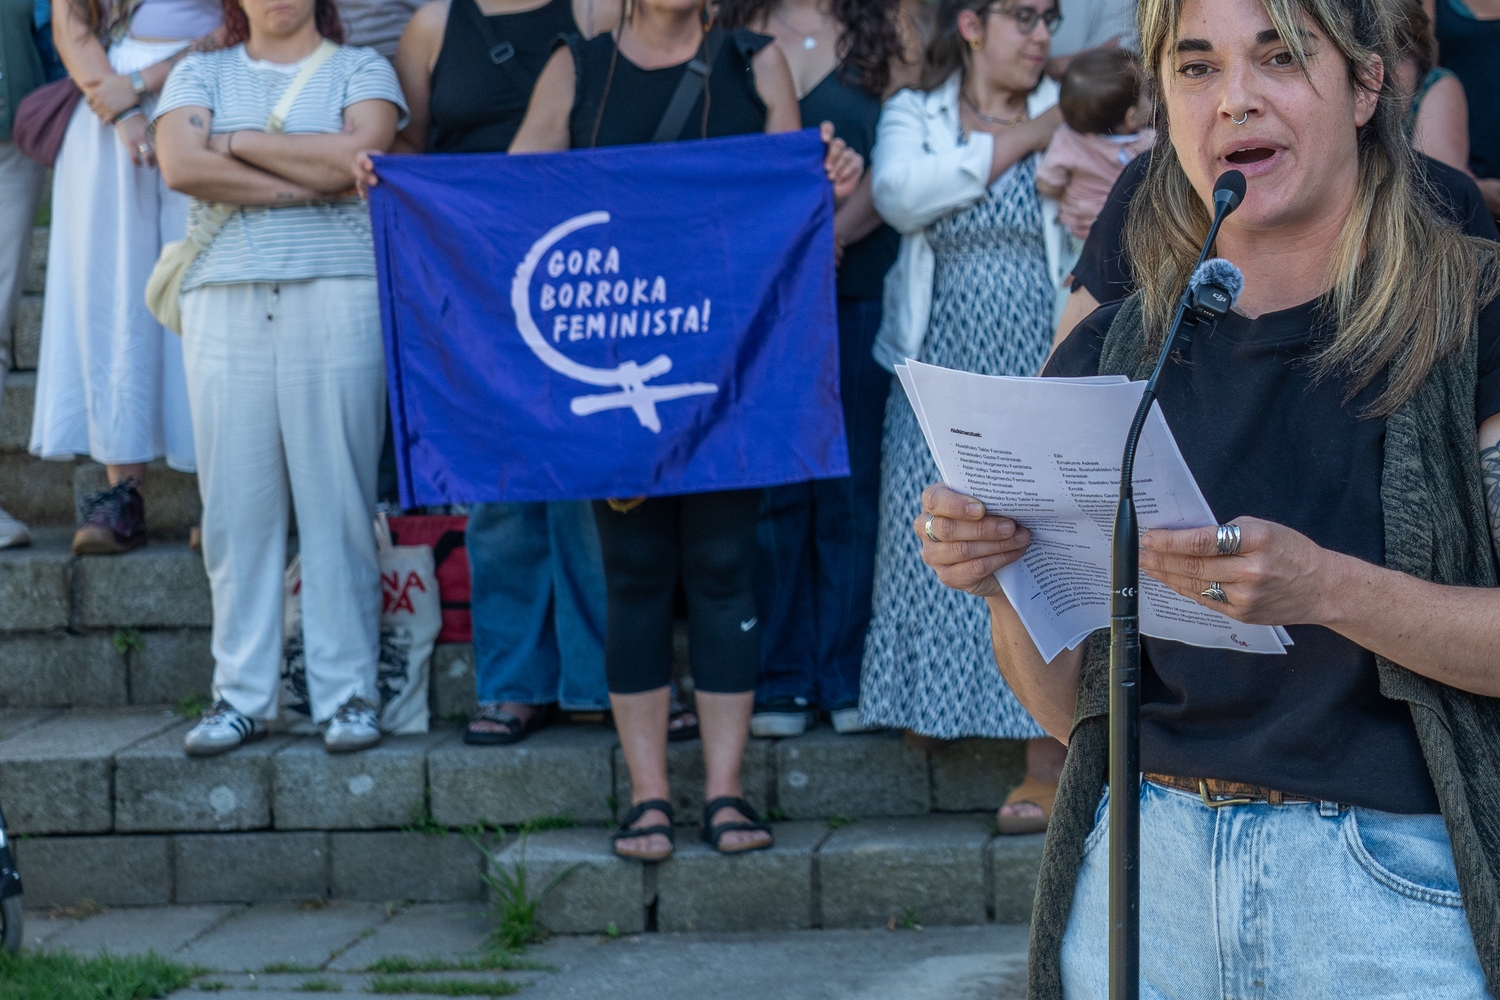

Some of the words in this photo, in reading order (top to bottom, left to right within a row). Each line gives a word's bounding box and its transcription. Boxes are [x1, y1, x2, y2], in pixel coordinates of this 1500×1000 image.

[548, 246, 620, 278] GORA
[540, 275, 667, 311] BORROKA
[553, 297, 711, 342] FEMINISTA!
